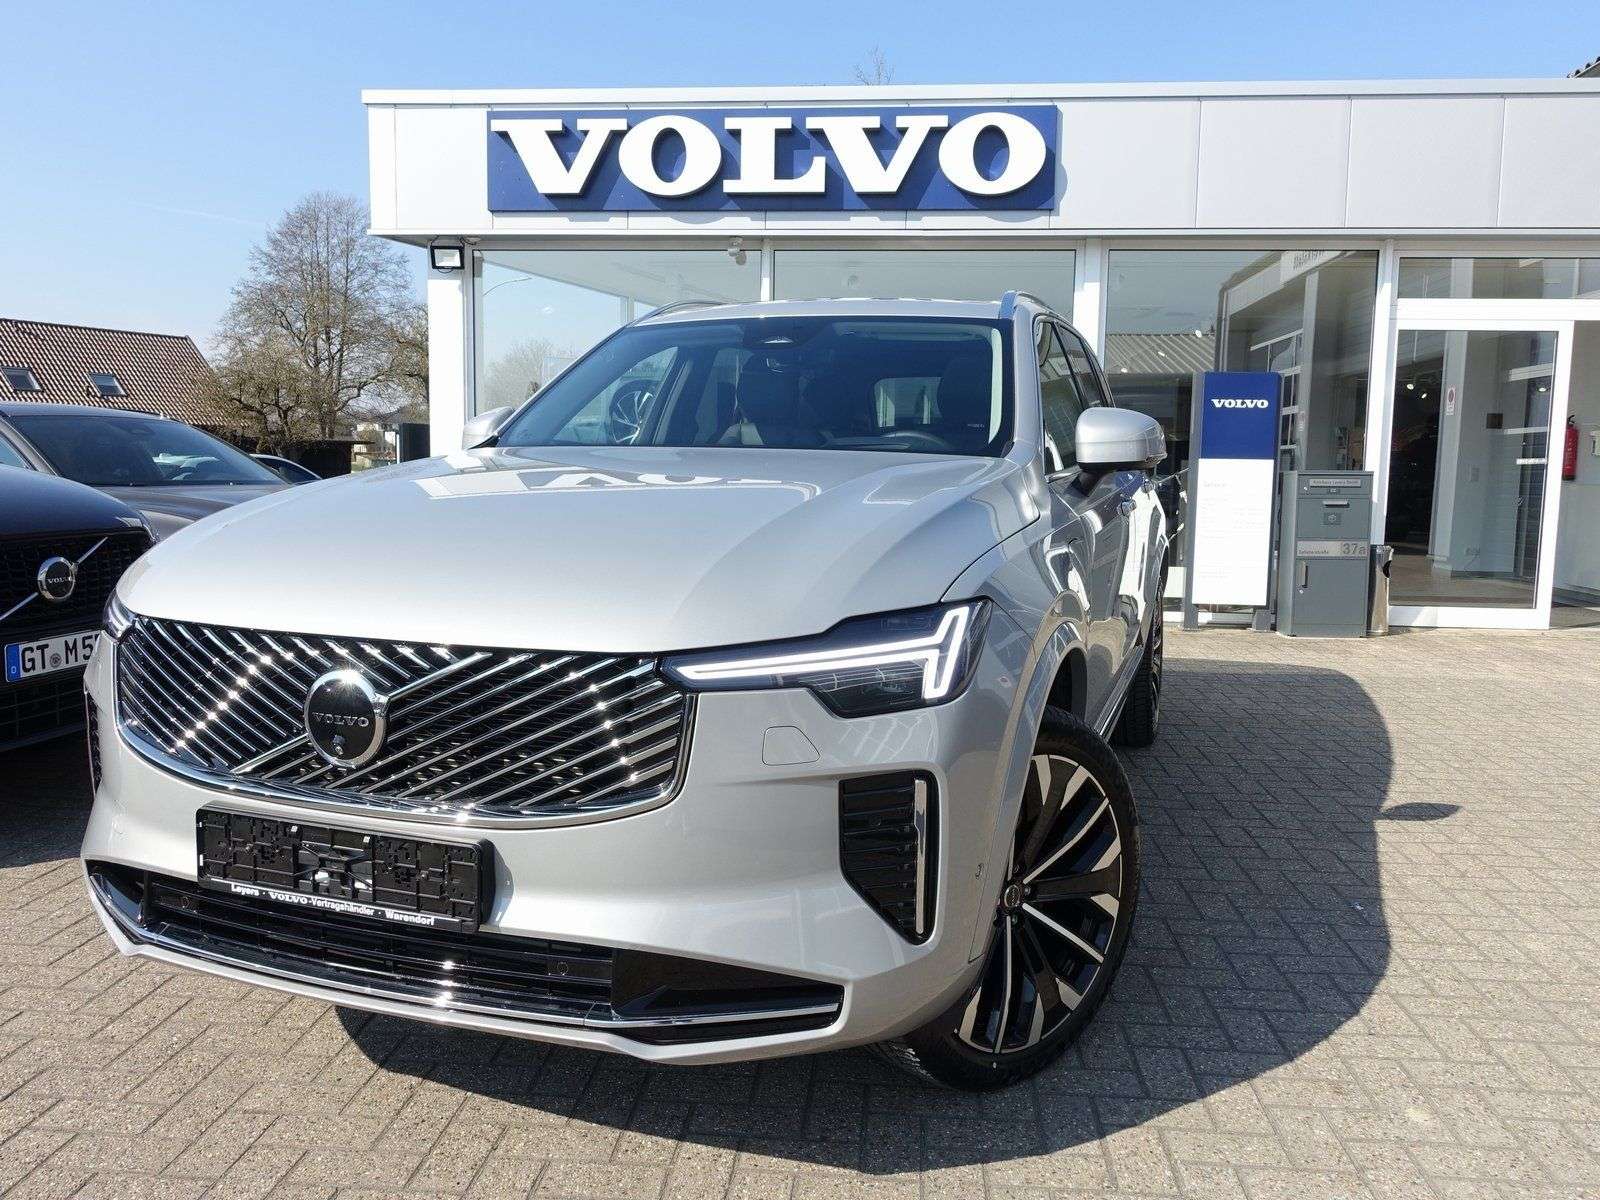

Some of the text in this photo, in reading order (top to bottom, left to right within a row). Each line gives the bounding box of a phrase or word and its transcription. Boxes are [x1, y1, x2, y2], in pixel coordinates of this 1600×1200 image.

[490, 111, 1047, 196] VOLVO
[1211, 398, 1269, 409] VOLVO
[1342, 542, 1367, 555] 37a
[21, 643, 50, 674] GT
[311, 711, 369, 728] VOLVO
[231, 882, 260, 896] Leyers
[384, 909, 435, 926] Warendorf
